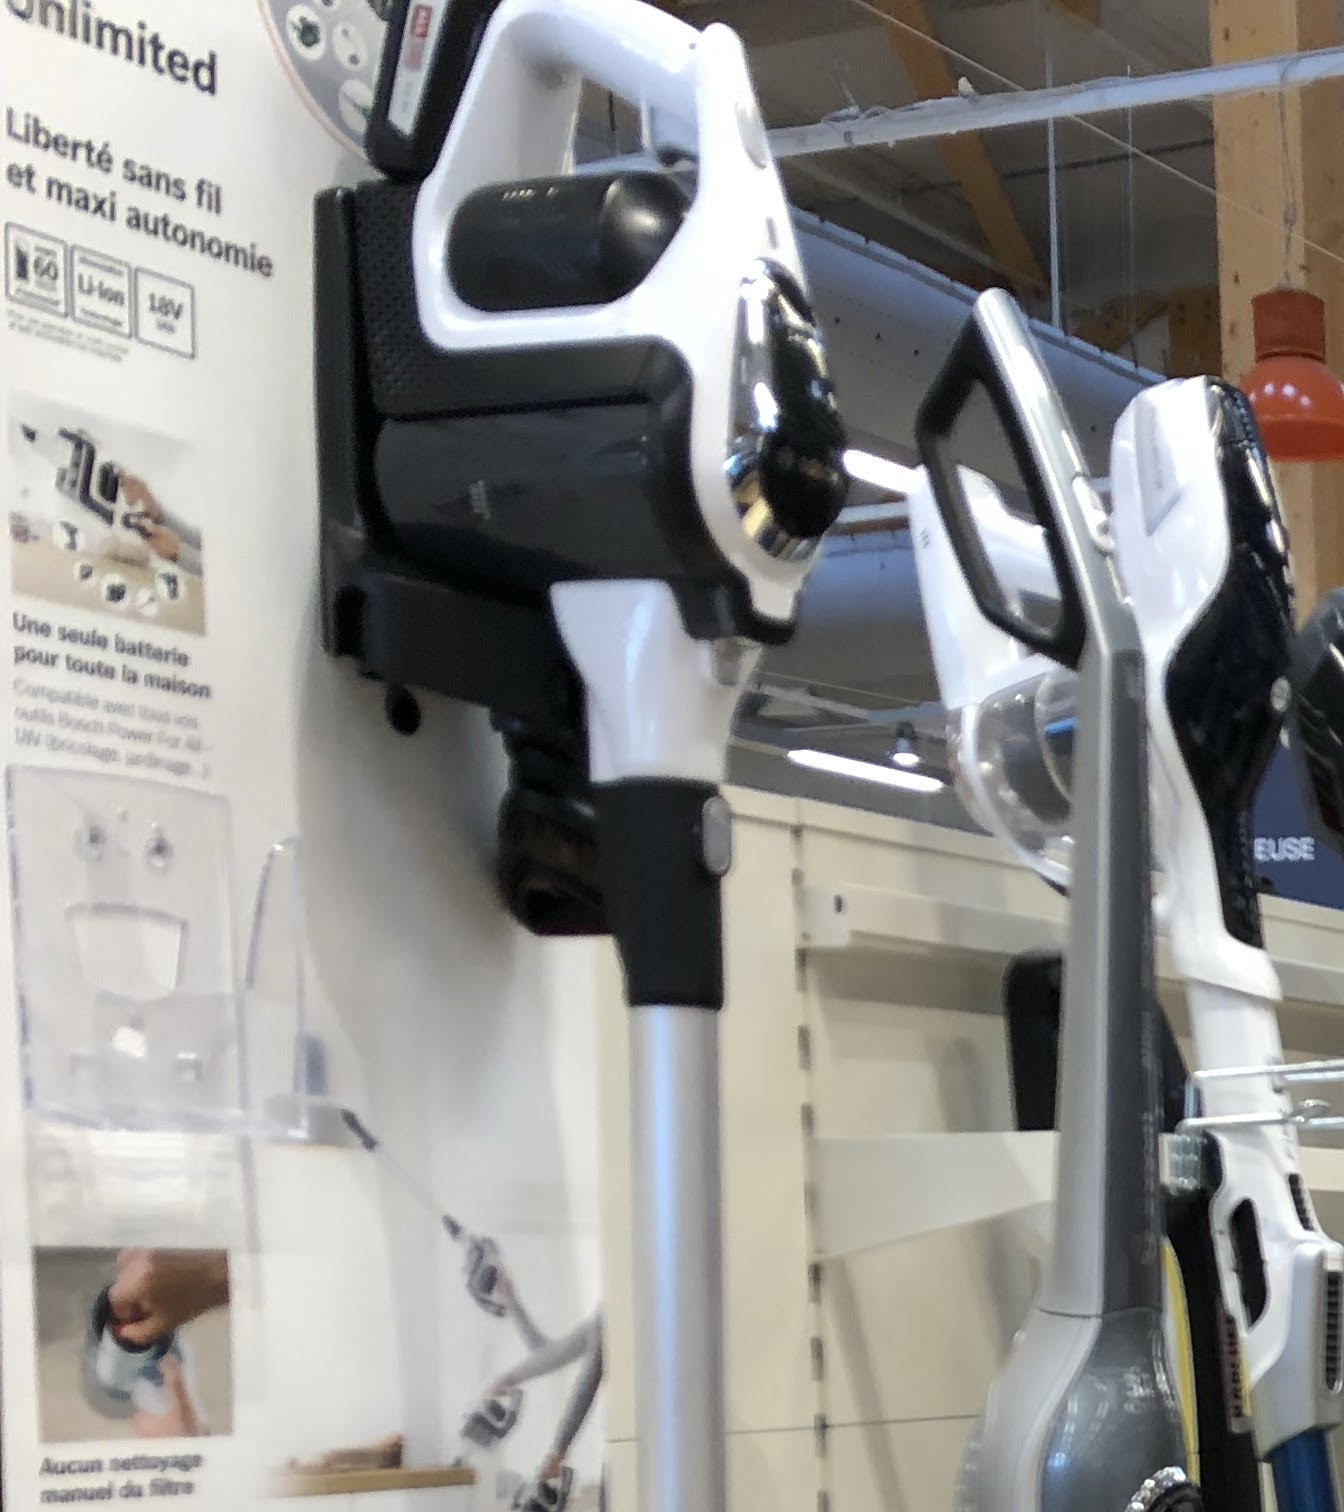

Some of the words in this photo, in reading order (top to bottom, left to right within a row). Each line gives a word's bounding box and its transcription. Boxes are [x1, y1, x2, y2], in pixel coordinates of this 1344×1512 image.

[6, 107, 113, 173] Liberté
[122, 157, 188, 201] sans
[195, 178, 223, 214] fil
[6, 162, 36, 194] et
[46, 176, 117, 222] maxi
[125, 205, 274, 278] autonomie
[12, 611, 51, 637] Une
[57, 625, 109, 650] seule
[114, 633, 189, 667] batterie
[14, 646, 59, 665] pour
[65, 653, 116, 679] toute
[122, 664, 138, 685] la
[143, 672, 211, 699] maison
